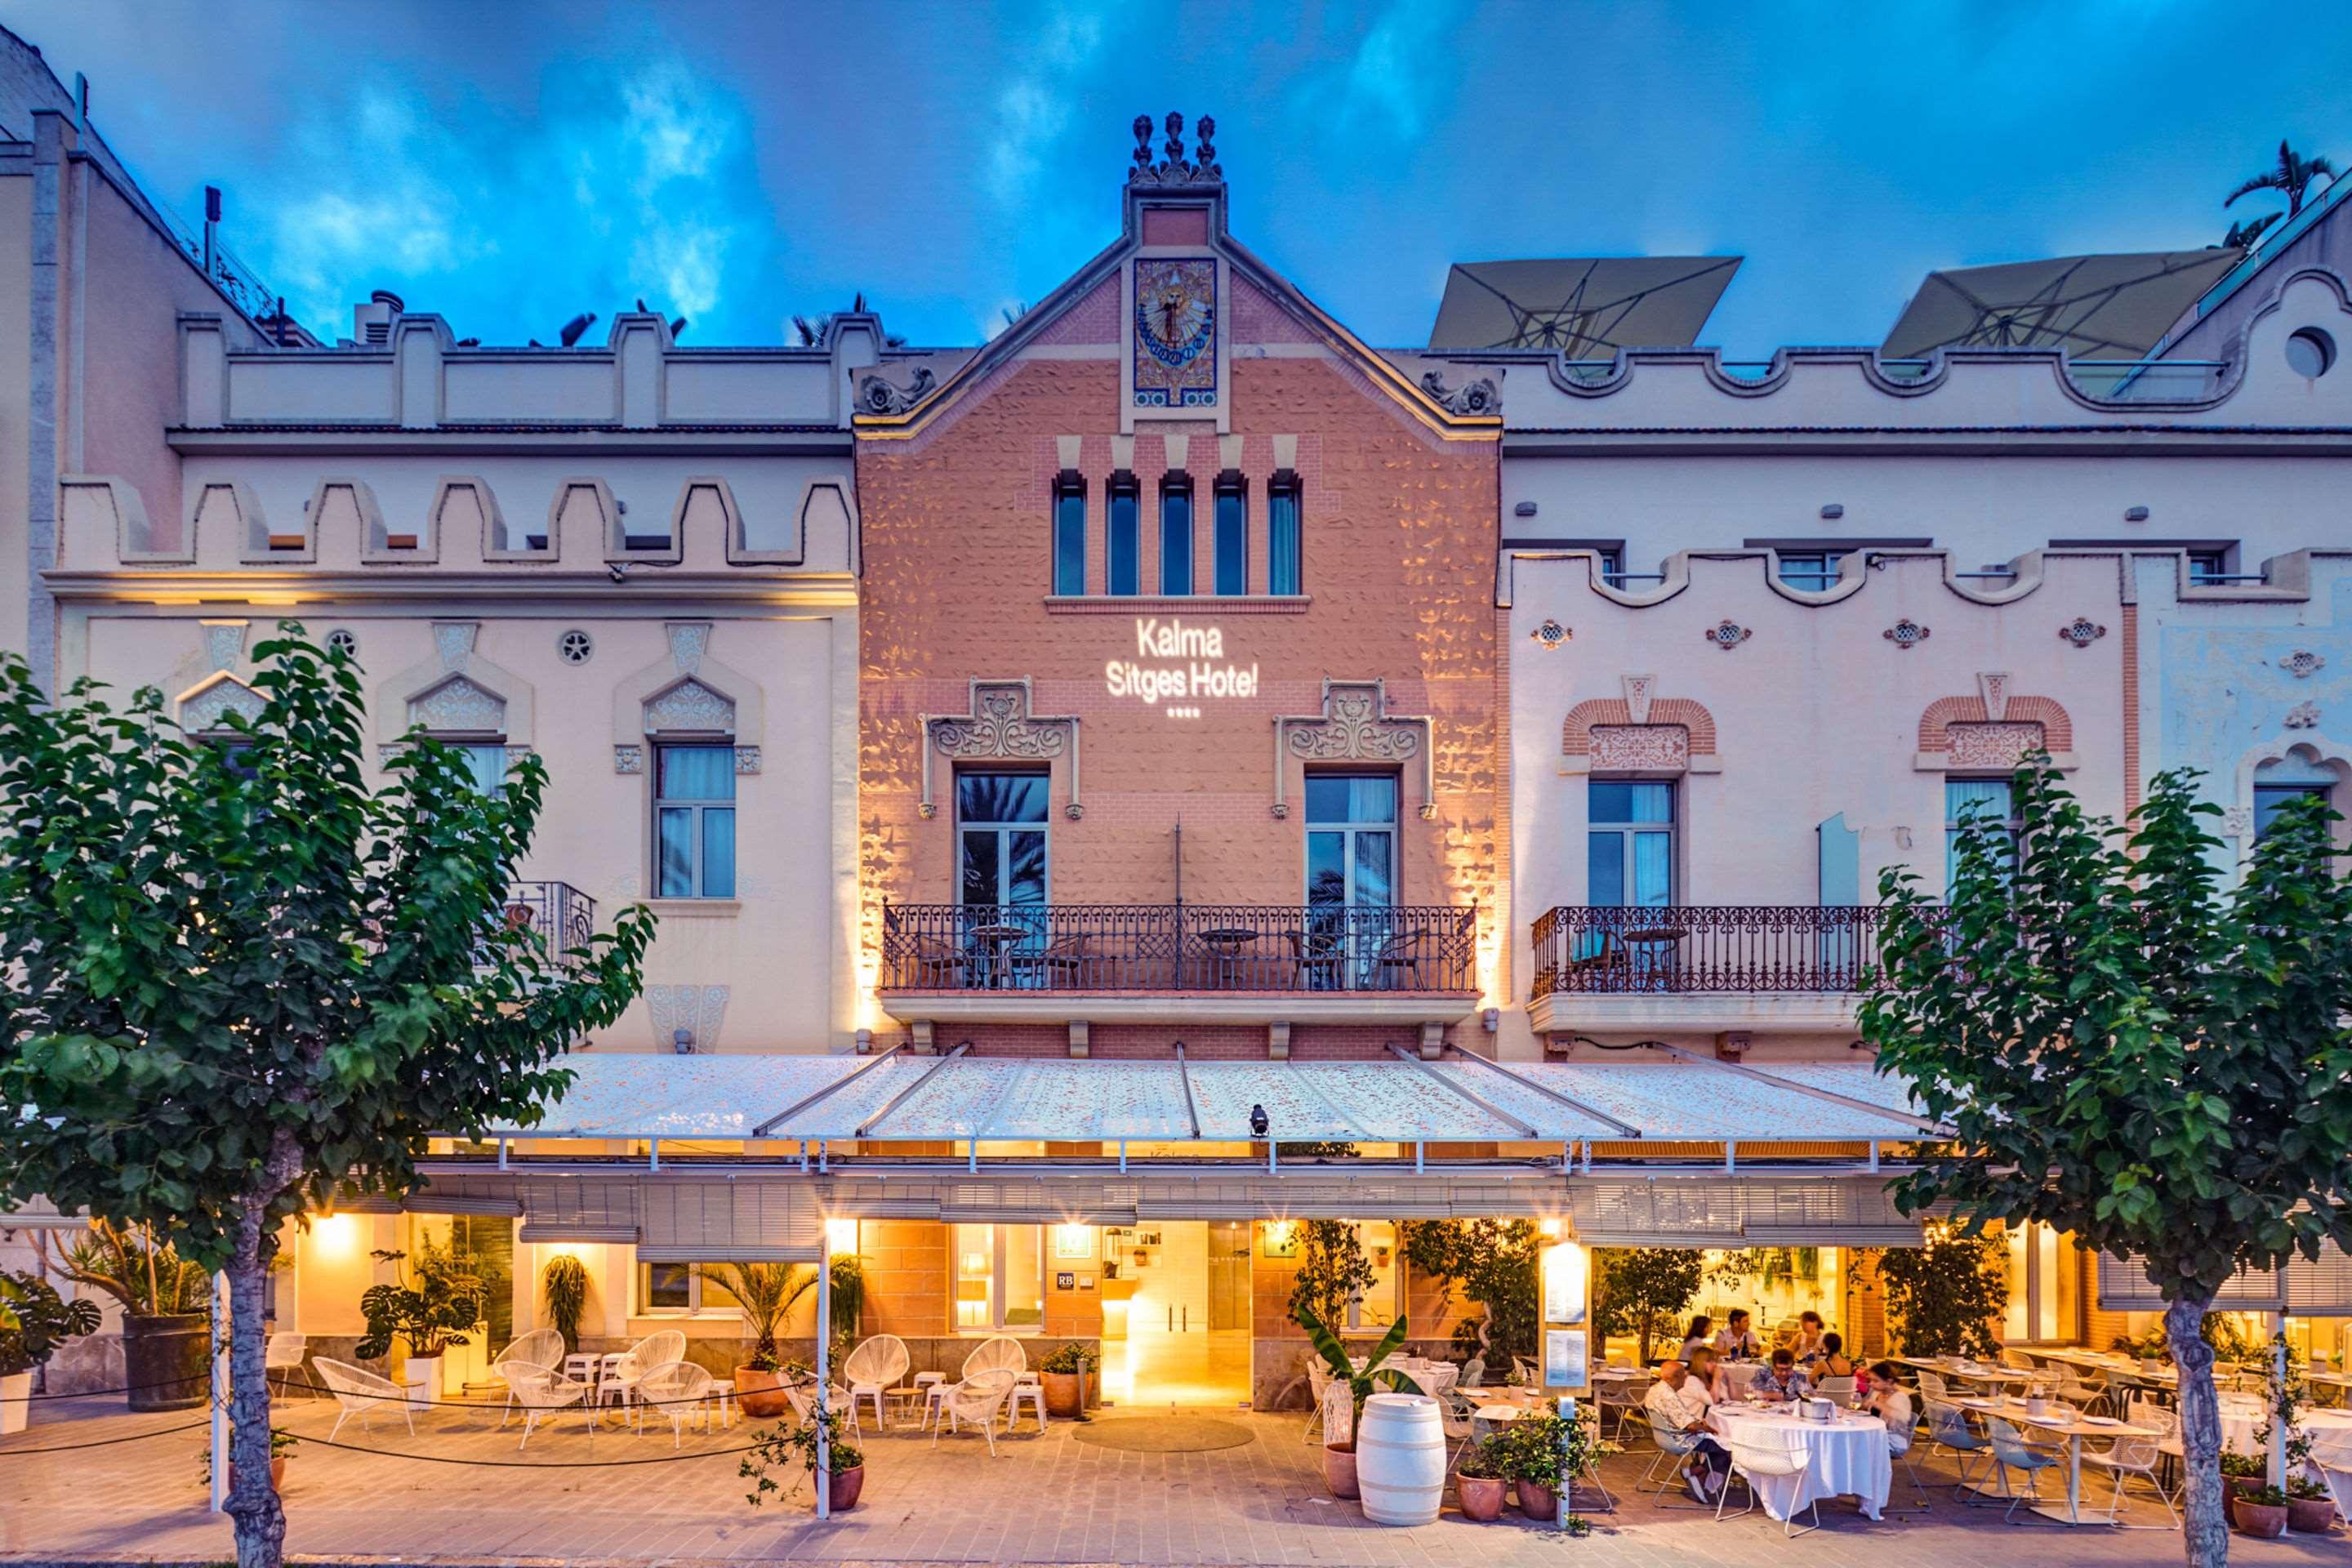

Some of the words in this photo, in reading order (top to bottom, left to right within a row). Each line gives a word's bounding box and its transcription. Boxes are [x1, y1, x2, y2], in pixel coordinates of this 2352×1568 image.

[1137, 618, 1223, 657] Kalma
[1106, 660, 1187, 704] Sitges
[1190, 662, 1258, 697] Hotel
[1058, 1276, 1073, 1285] RB
